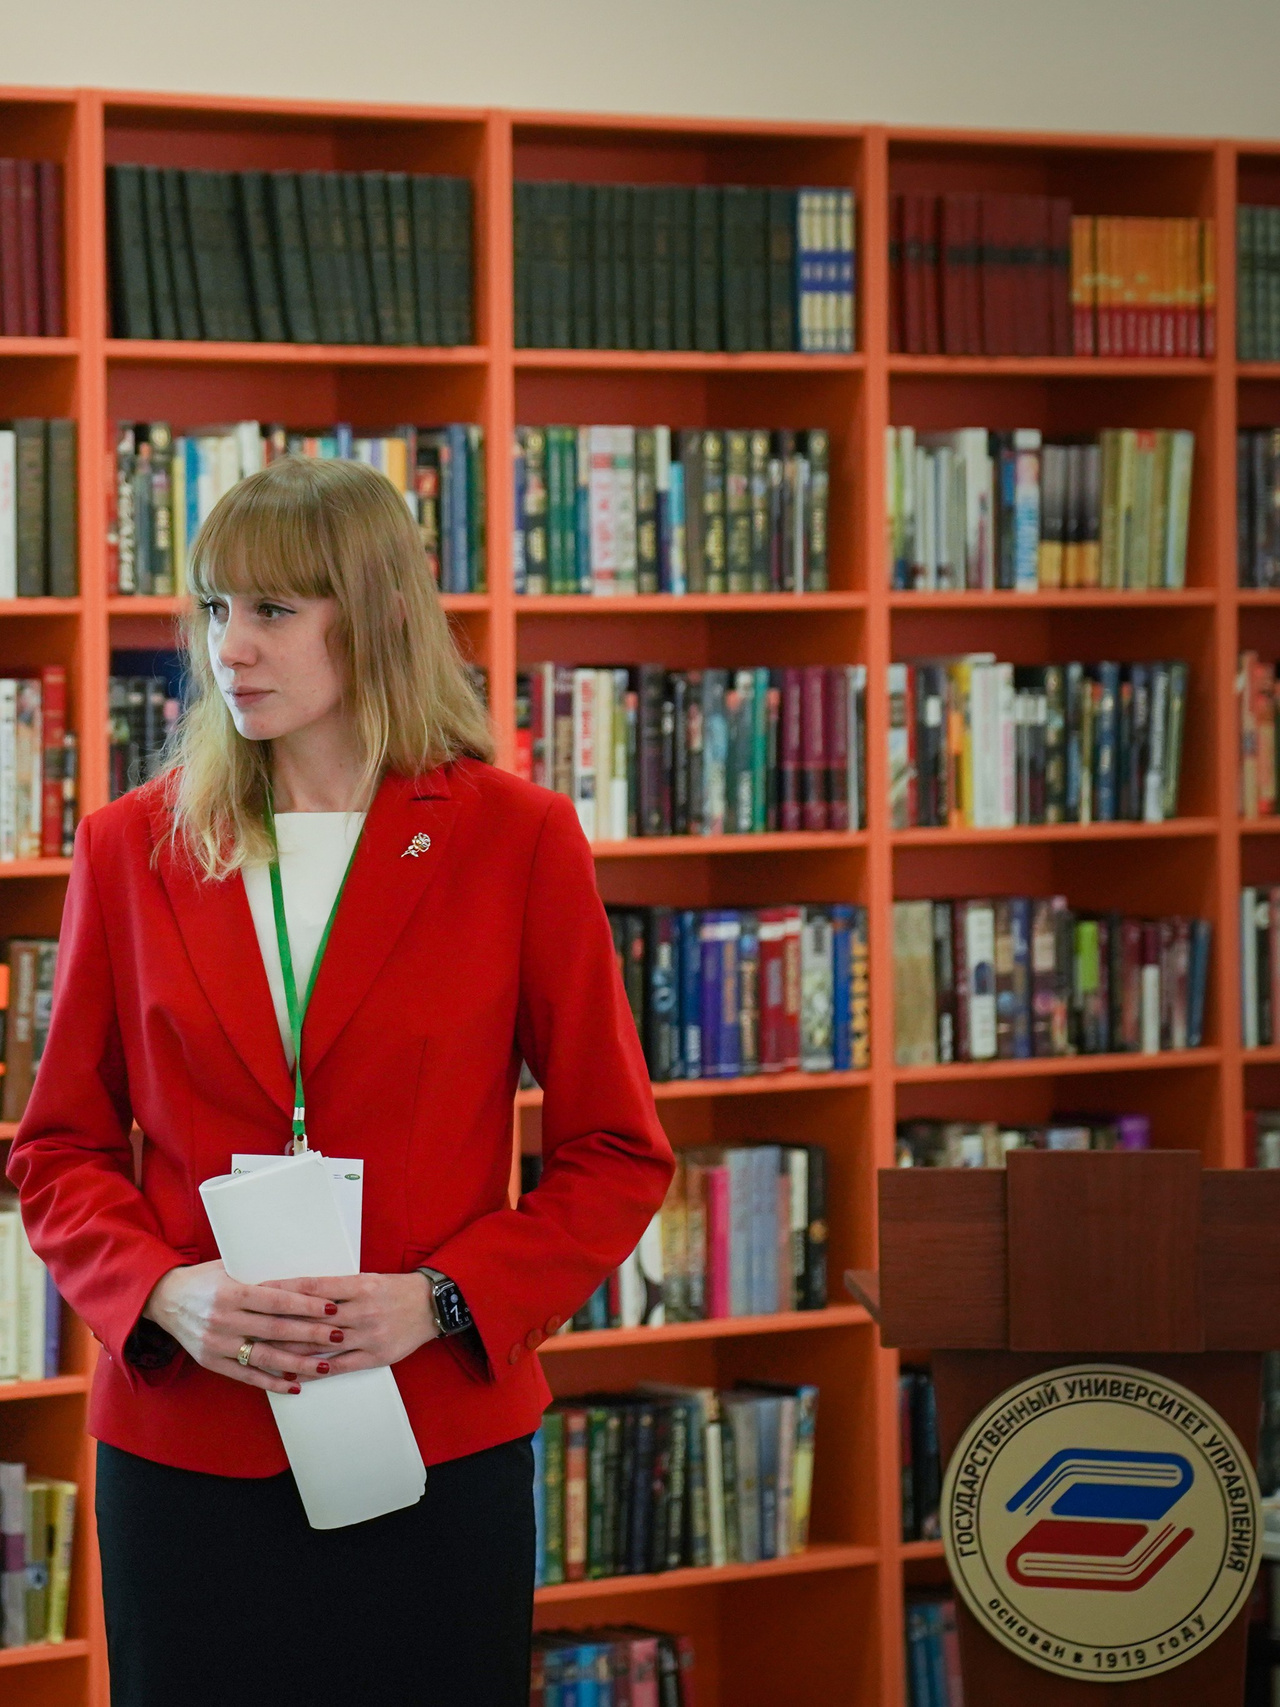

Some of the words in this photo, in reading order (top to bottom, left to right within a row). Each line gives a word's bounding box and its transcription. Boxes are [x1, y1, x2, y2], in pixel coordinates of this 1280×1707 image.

[955, 1382, 1061, 1558] ГОСУДАРСТВЕННЫЙ
[1064, 1378, 1208, 1436] УНИВЕРСИТЕТ
[1202, 1434, 1251, 1573] УПРАВЛЕНИЯ
[1093, 1649, 1147, 1668] 1919
